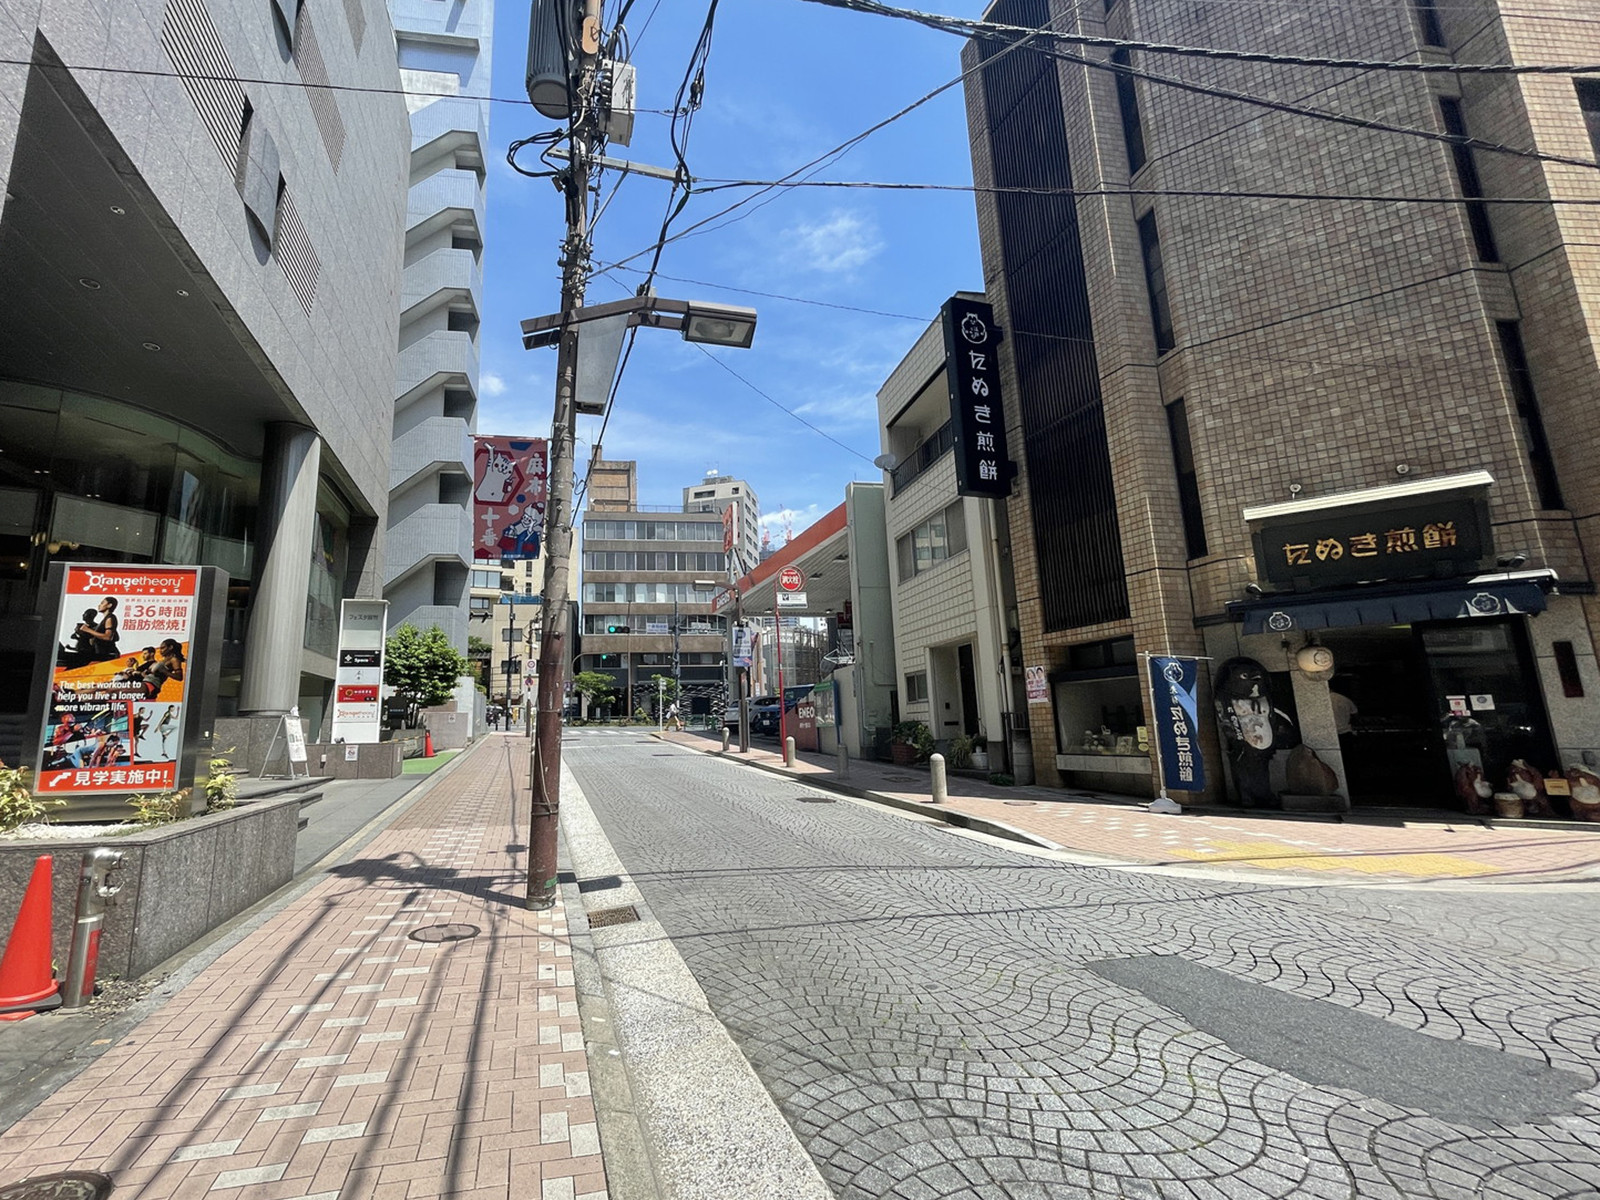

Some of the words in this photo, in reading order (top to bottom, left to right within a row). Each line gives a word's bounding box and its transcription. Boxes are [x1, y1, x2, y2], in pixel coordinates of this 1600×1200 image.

[968, 350, 997, 480] たぬき煎餅
[526, 452, 545, 496] 麻布
[480, 507, 501, 547] 十番
[1282, 521, 1457, 566] たぬき煎餅
[83, 570, 181, 591] Orangetheory
[60, 680, 75, 689] The
[77, 680, 96, 689] best
[57, 692, 76, 700] help
[95, 692, 110, 700] live
[118, 692, 146, 701] longer,
[80, 703, 110, 712] vibrant
[111, 703, 127, 712] life.
[73, 769, 169, 786] 見学実施中!
